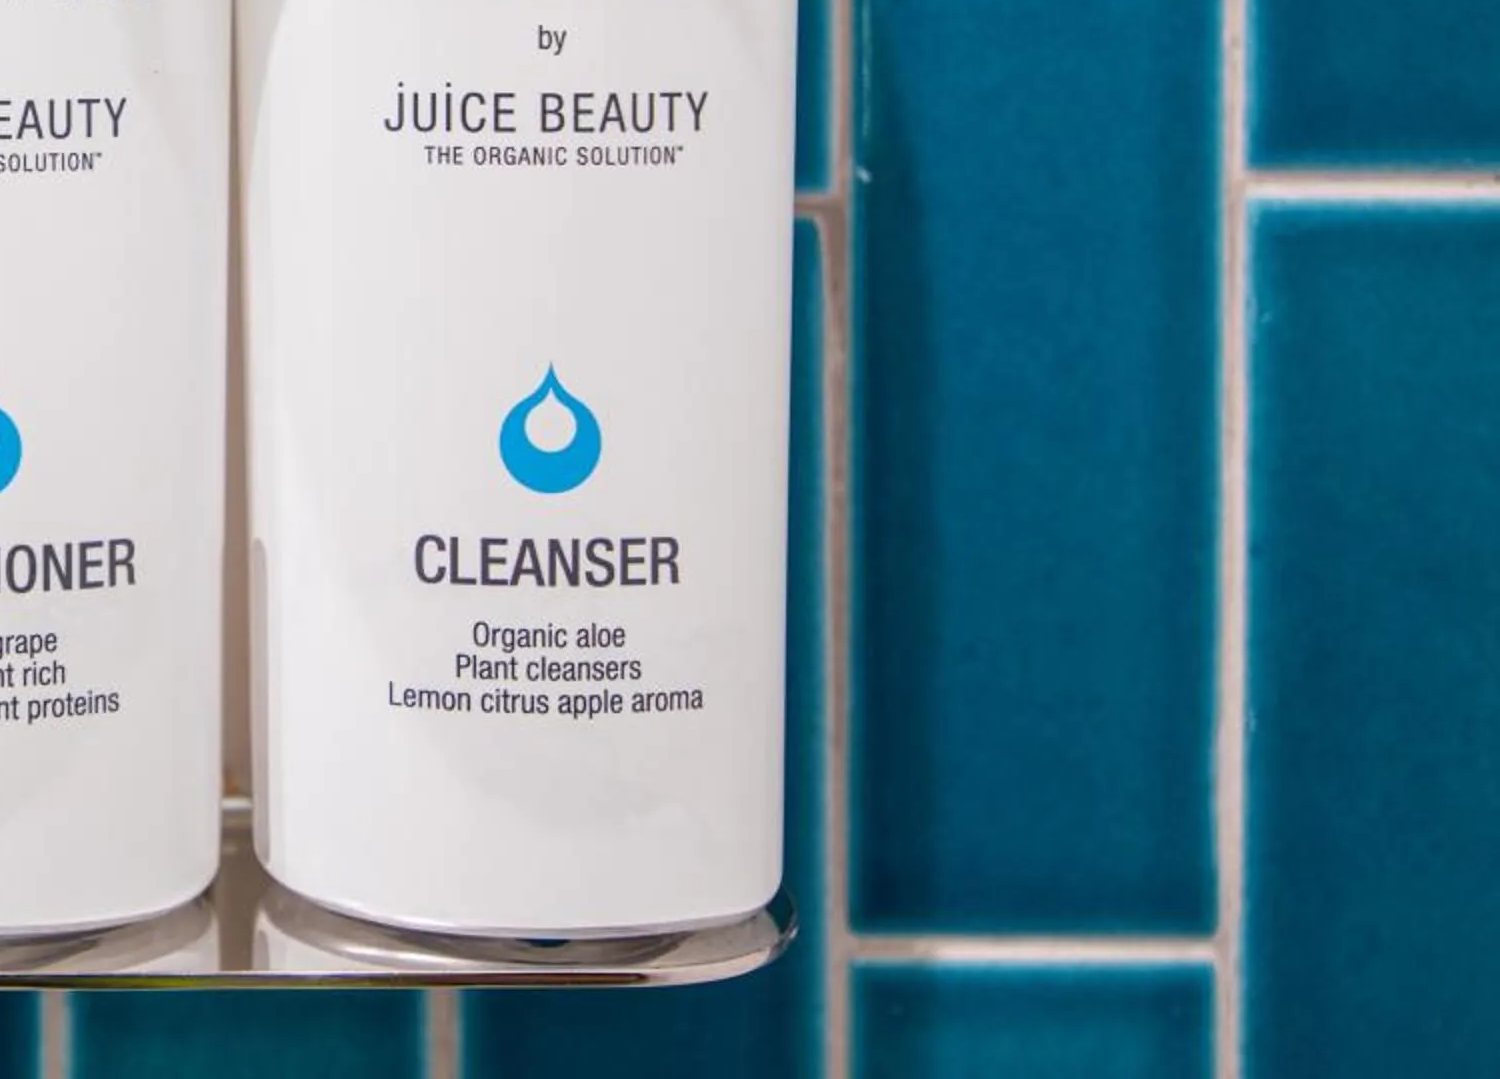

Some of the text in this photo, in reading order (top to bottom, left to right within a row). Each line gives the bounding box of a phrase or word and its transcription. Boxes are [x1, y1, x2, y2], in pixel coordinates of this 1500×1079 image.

[537, 24, 568, 57] by
[539, 90, 709, 134] BEAUTY
[423, 144, 464, 166] THE
[473, 145, 568, 167] ORGANIC
[414, 533, 681, 588] CLEANSER
[472, 620, 627, 654] Organic aloe
[22, 659, 66, 688] rich
[455, 652, 643, 682] Plant cleansers
[27, 689, 121, 726] proteins
[388, 680, 704, 721] Lemon citrus apple aroma
